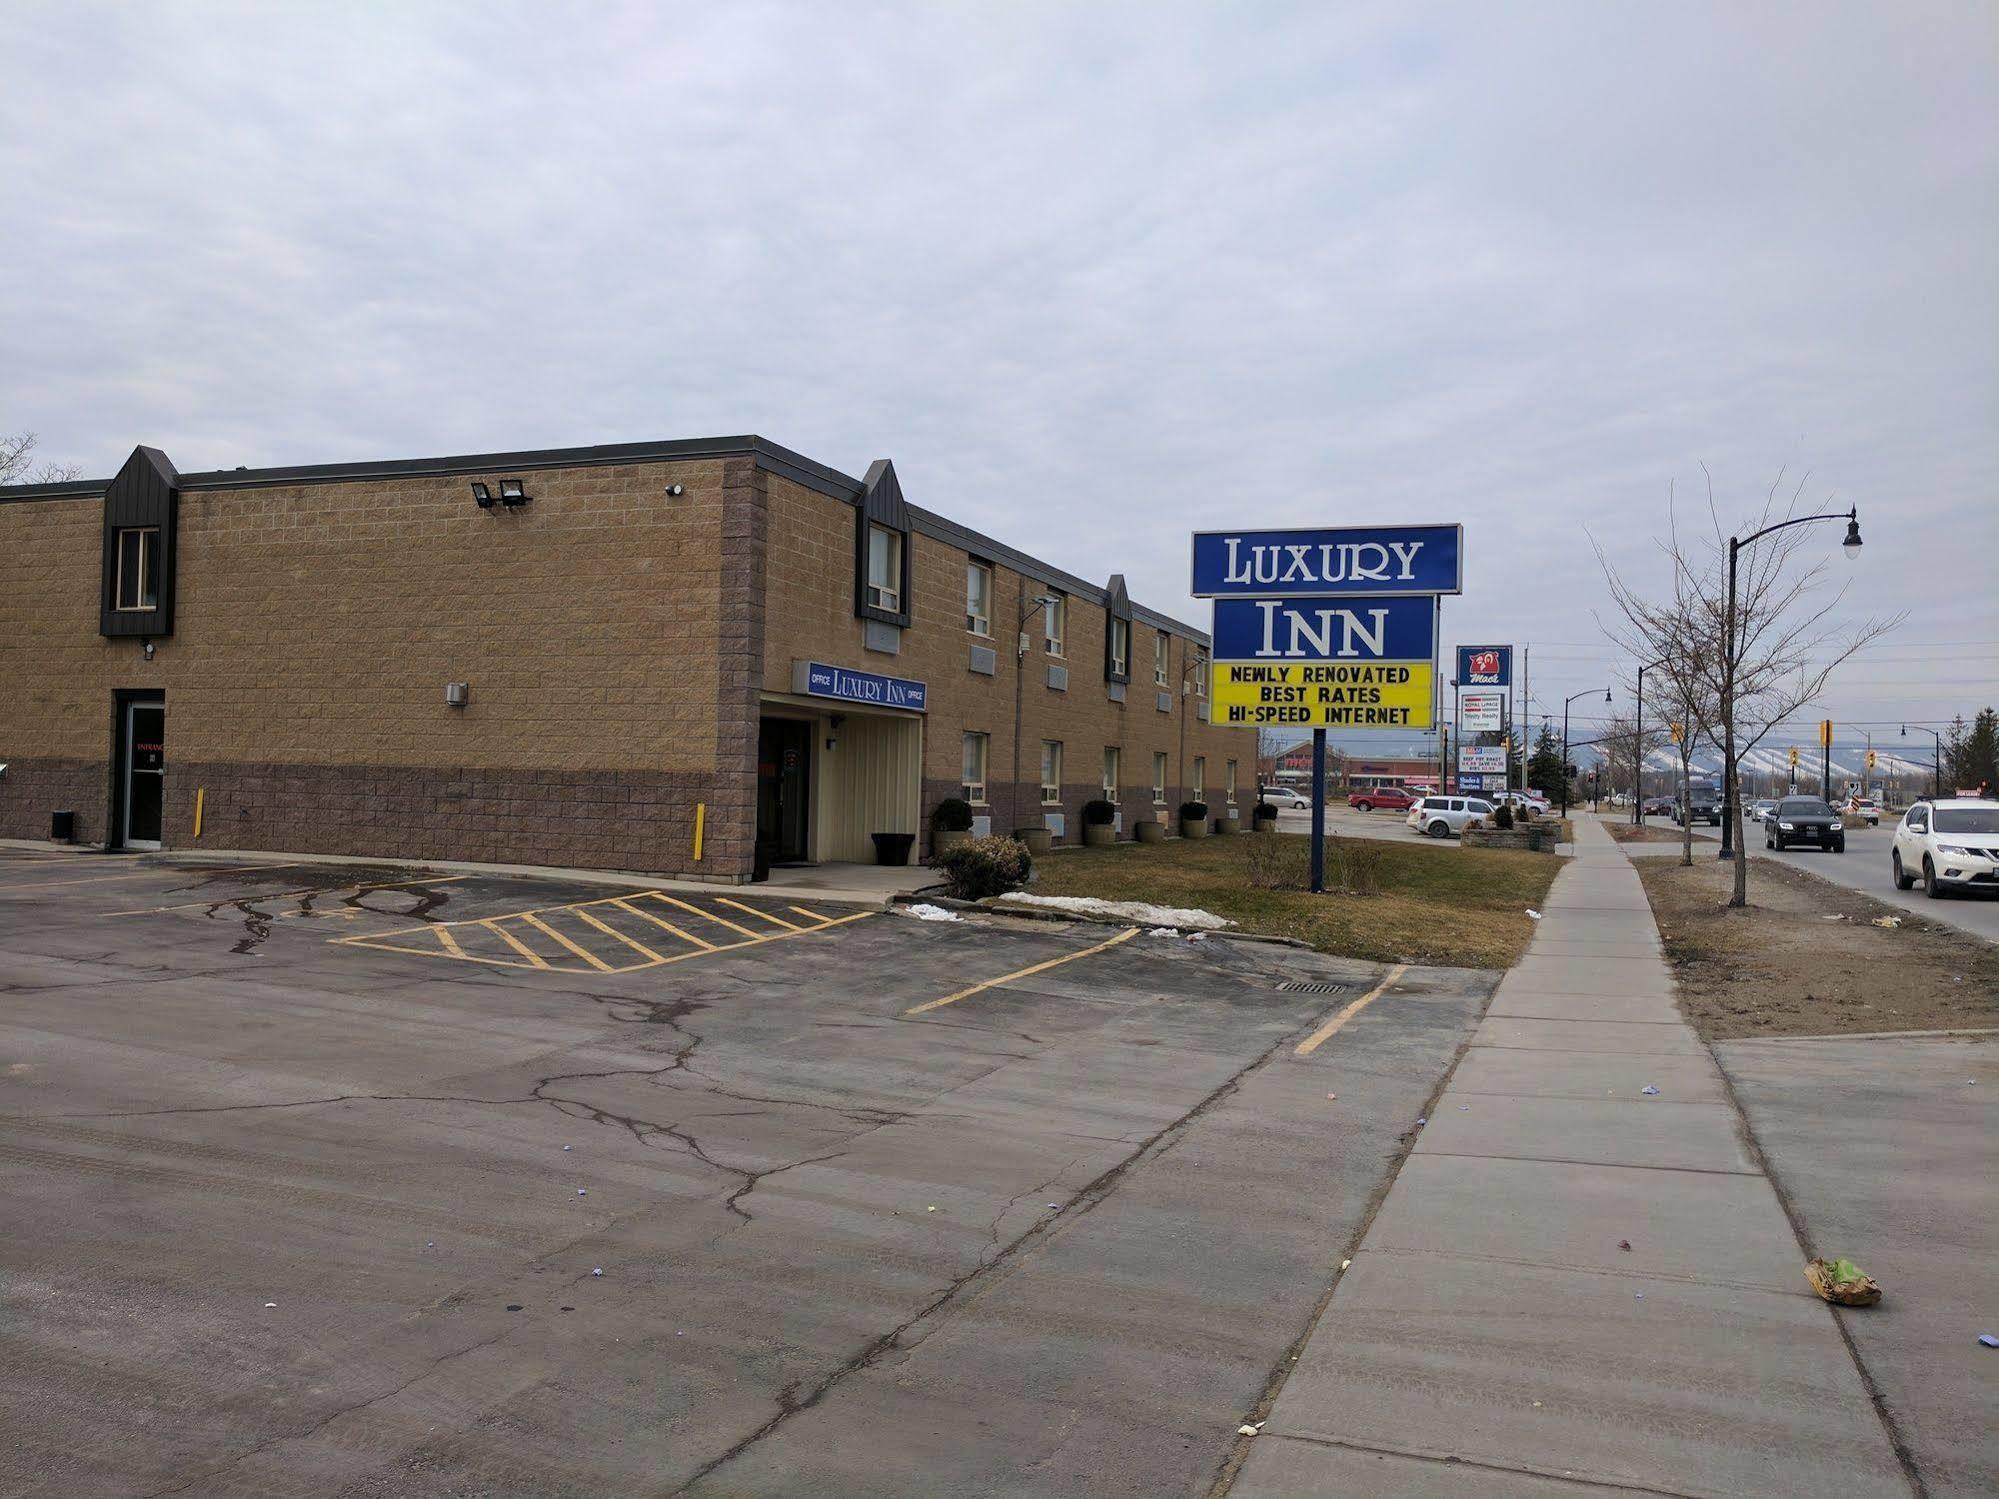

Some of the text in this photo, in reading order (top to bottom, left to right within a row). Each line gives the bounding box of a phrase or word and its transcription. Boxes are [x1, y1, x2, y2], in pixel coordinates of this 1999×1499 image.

[1224, 538, 1424, 585] LUXURY
[1255, 600, 1389, 657] INN
[811, 670, 924, 704] OFFICE LUXURY INN OFFICE
[1230, 666, 1410, 683] NEWLY RENOVATED
[1260, 686, 1381, 703] BEST RATES
[1228, 706, 1411, 725] HI-SPEED INTERNET
